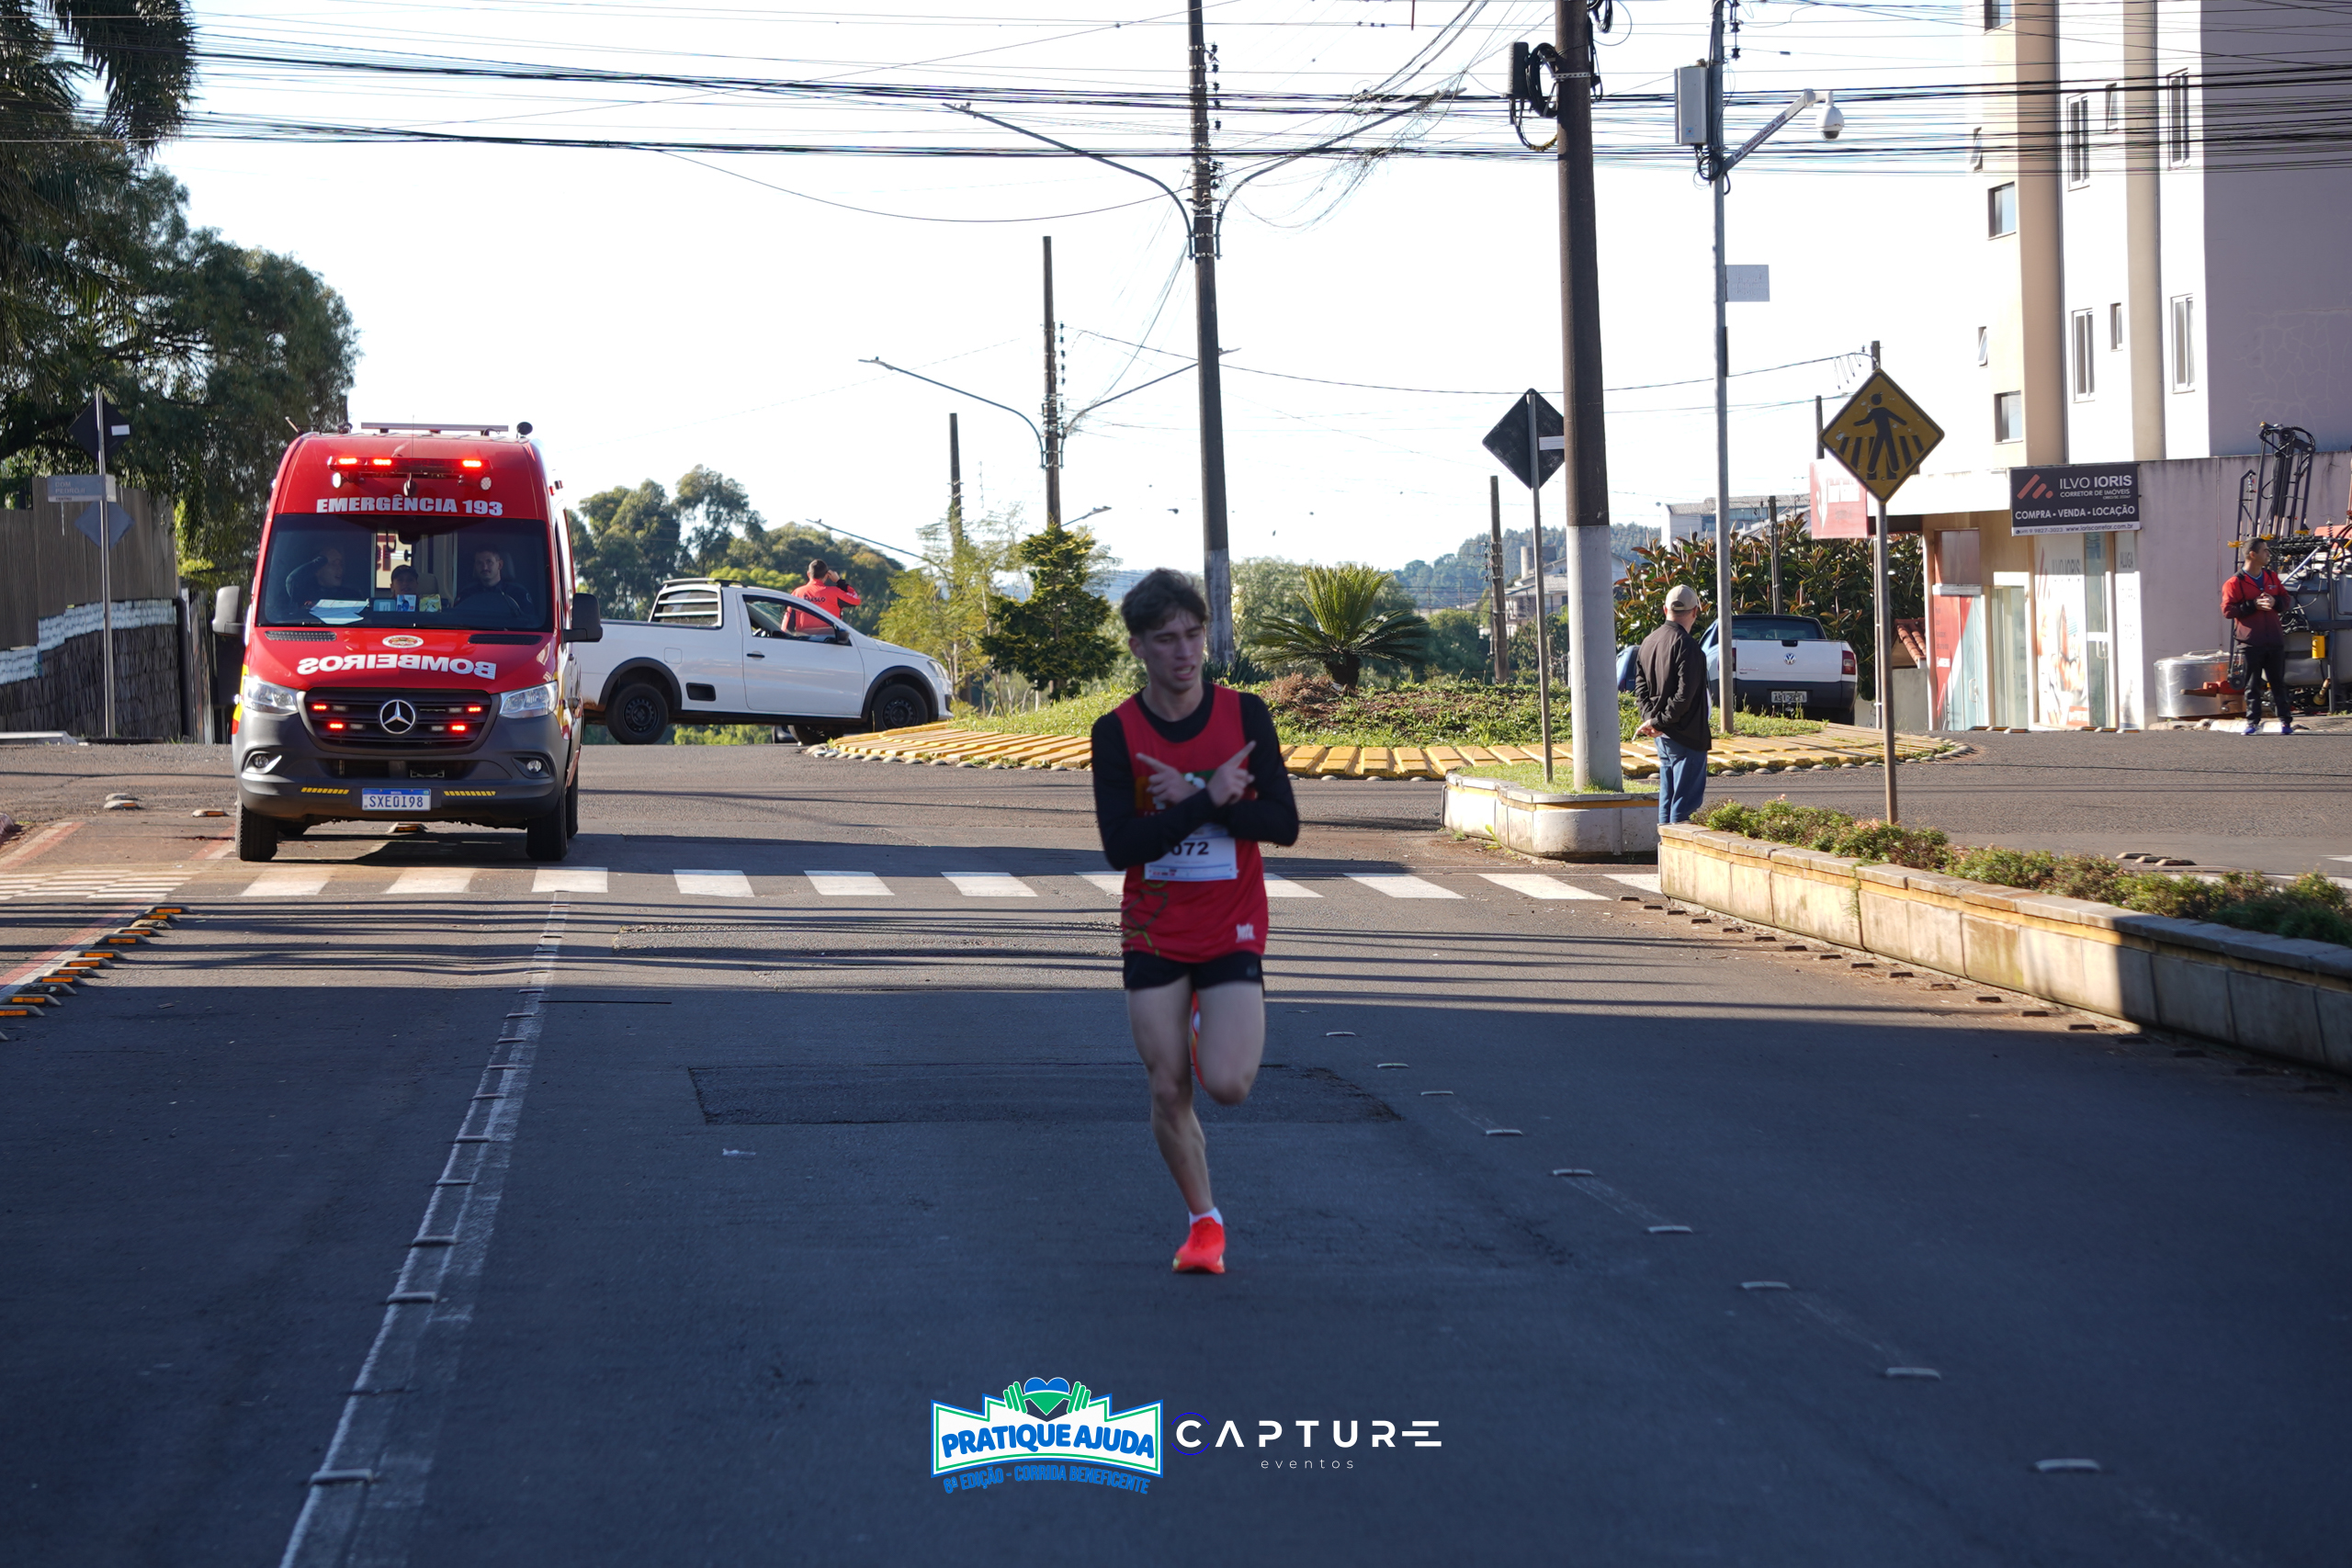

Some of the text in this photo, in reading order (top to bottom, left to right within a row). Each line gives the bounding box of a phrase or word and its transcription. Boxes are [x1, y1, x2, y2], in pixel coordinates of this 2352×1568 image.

[2059, 475, 2132, 490] ILVO IORIS
[2060, 490, 2094, 498] CORRETOR
[2104, 488, 2131, 496] IMÓVEIS
[316, 494, 503, 516] EMERGÊNCIA 193
[2015, 509, 2052, 520] COMPRA
[2057, 507, 2086, 518] VENDA
[2092, 503, 2135, 517] LOCAÇÃO
